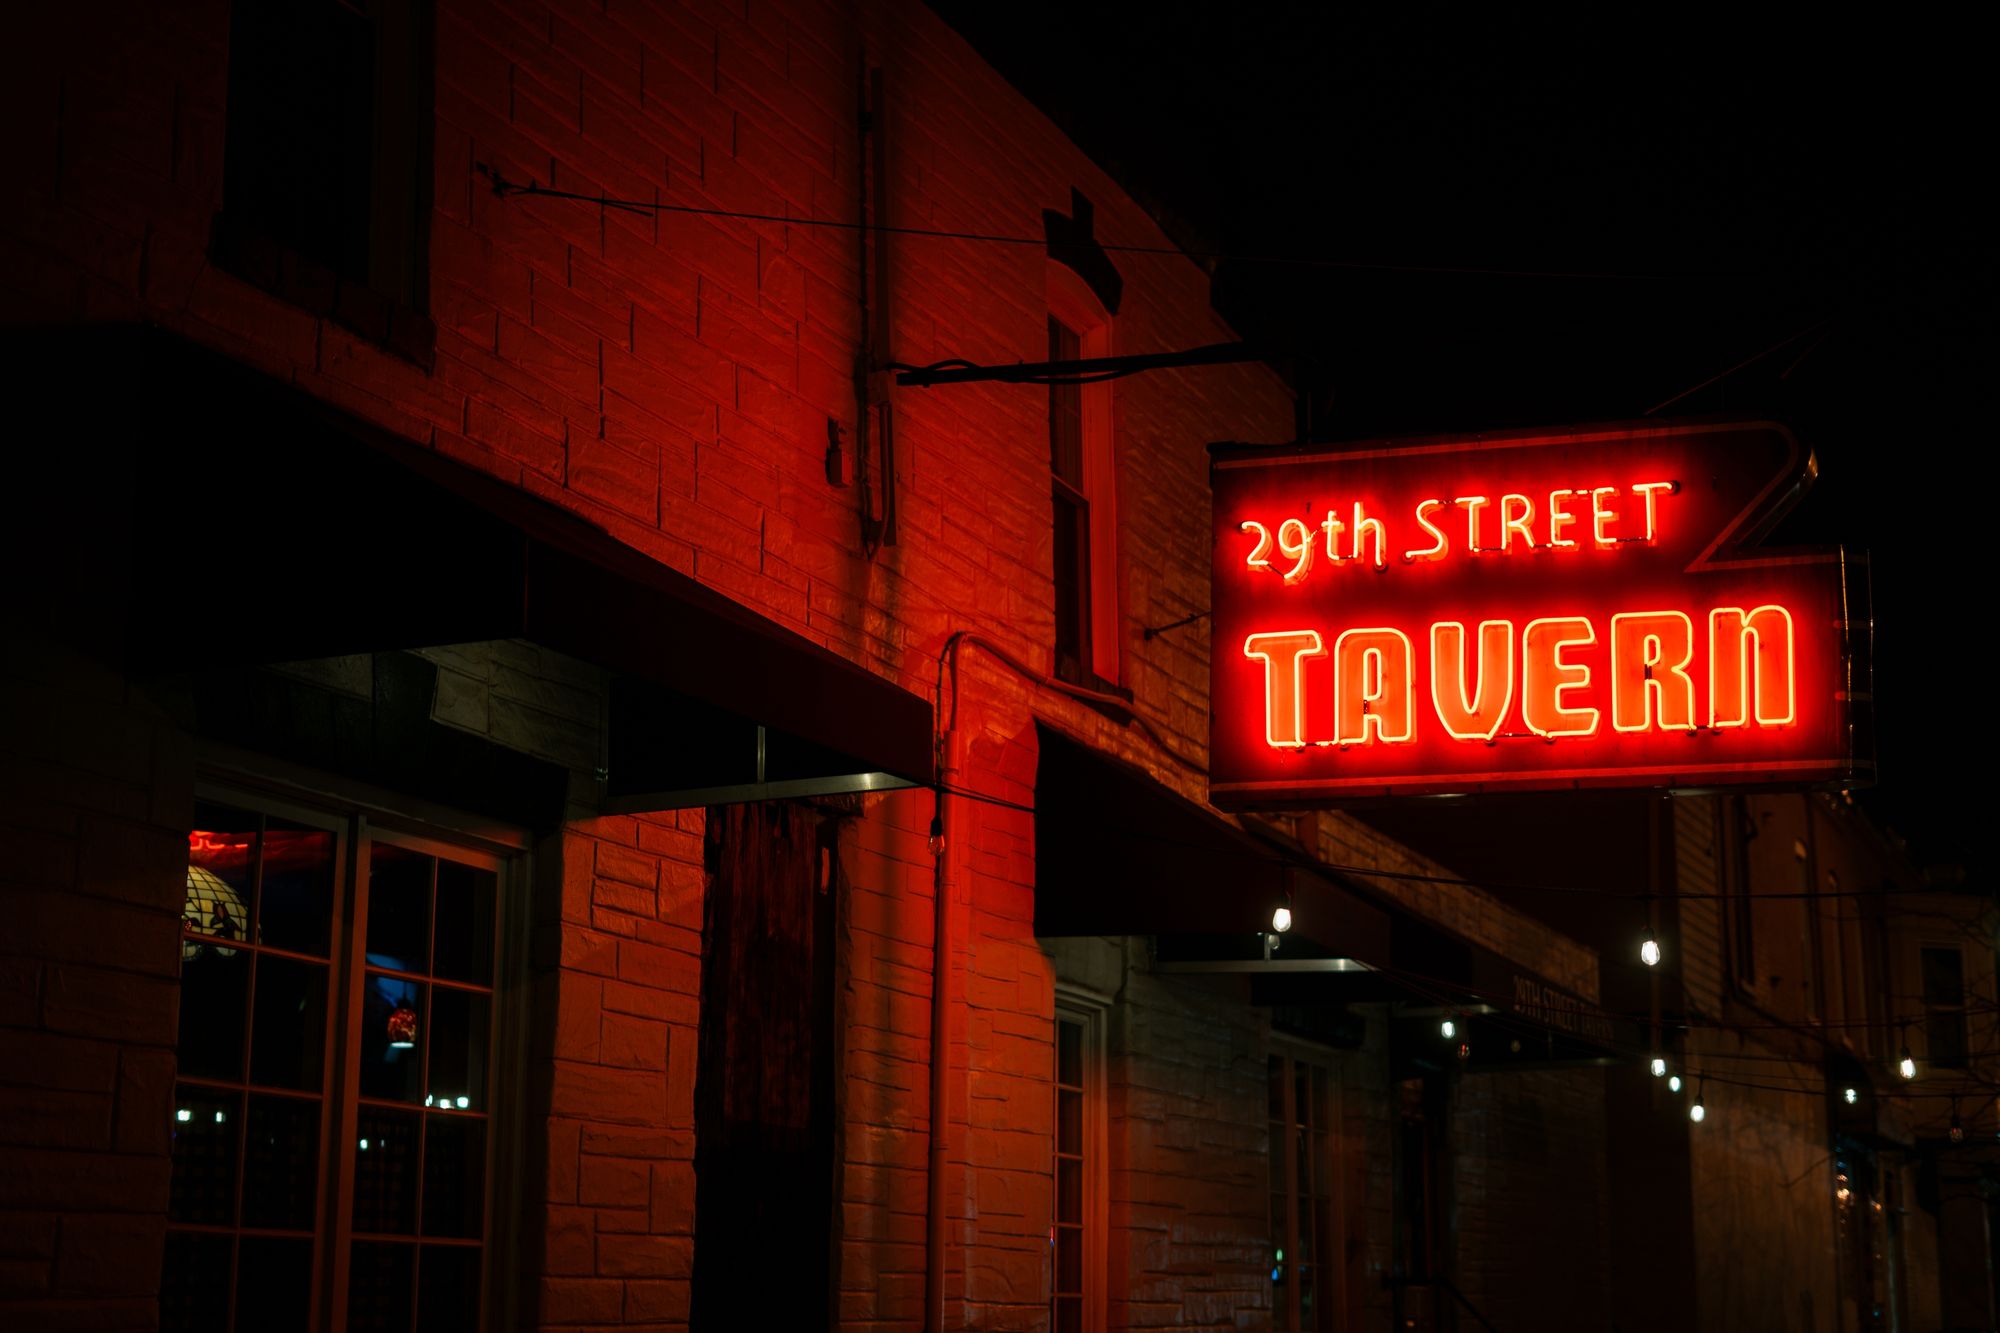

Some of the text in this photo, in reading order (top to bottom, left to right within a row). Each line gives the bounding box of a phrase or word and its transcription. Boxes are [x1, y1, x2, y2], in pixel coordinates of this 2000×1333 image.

[1240, 481, 1674, 585] 29th STREET
[1242, 604, 1798, 748] TAVERN
